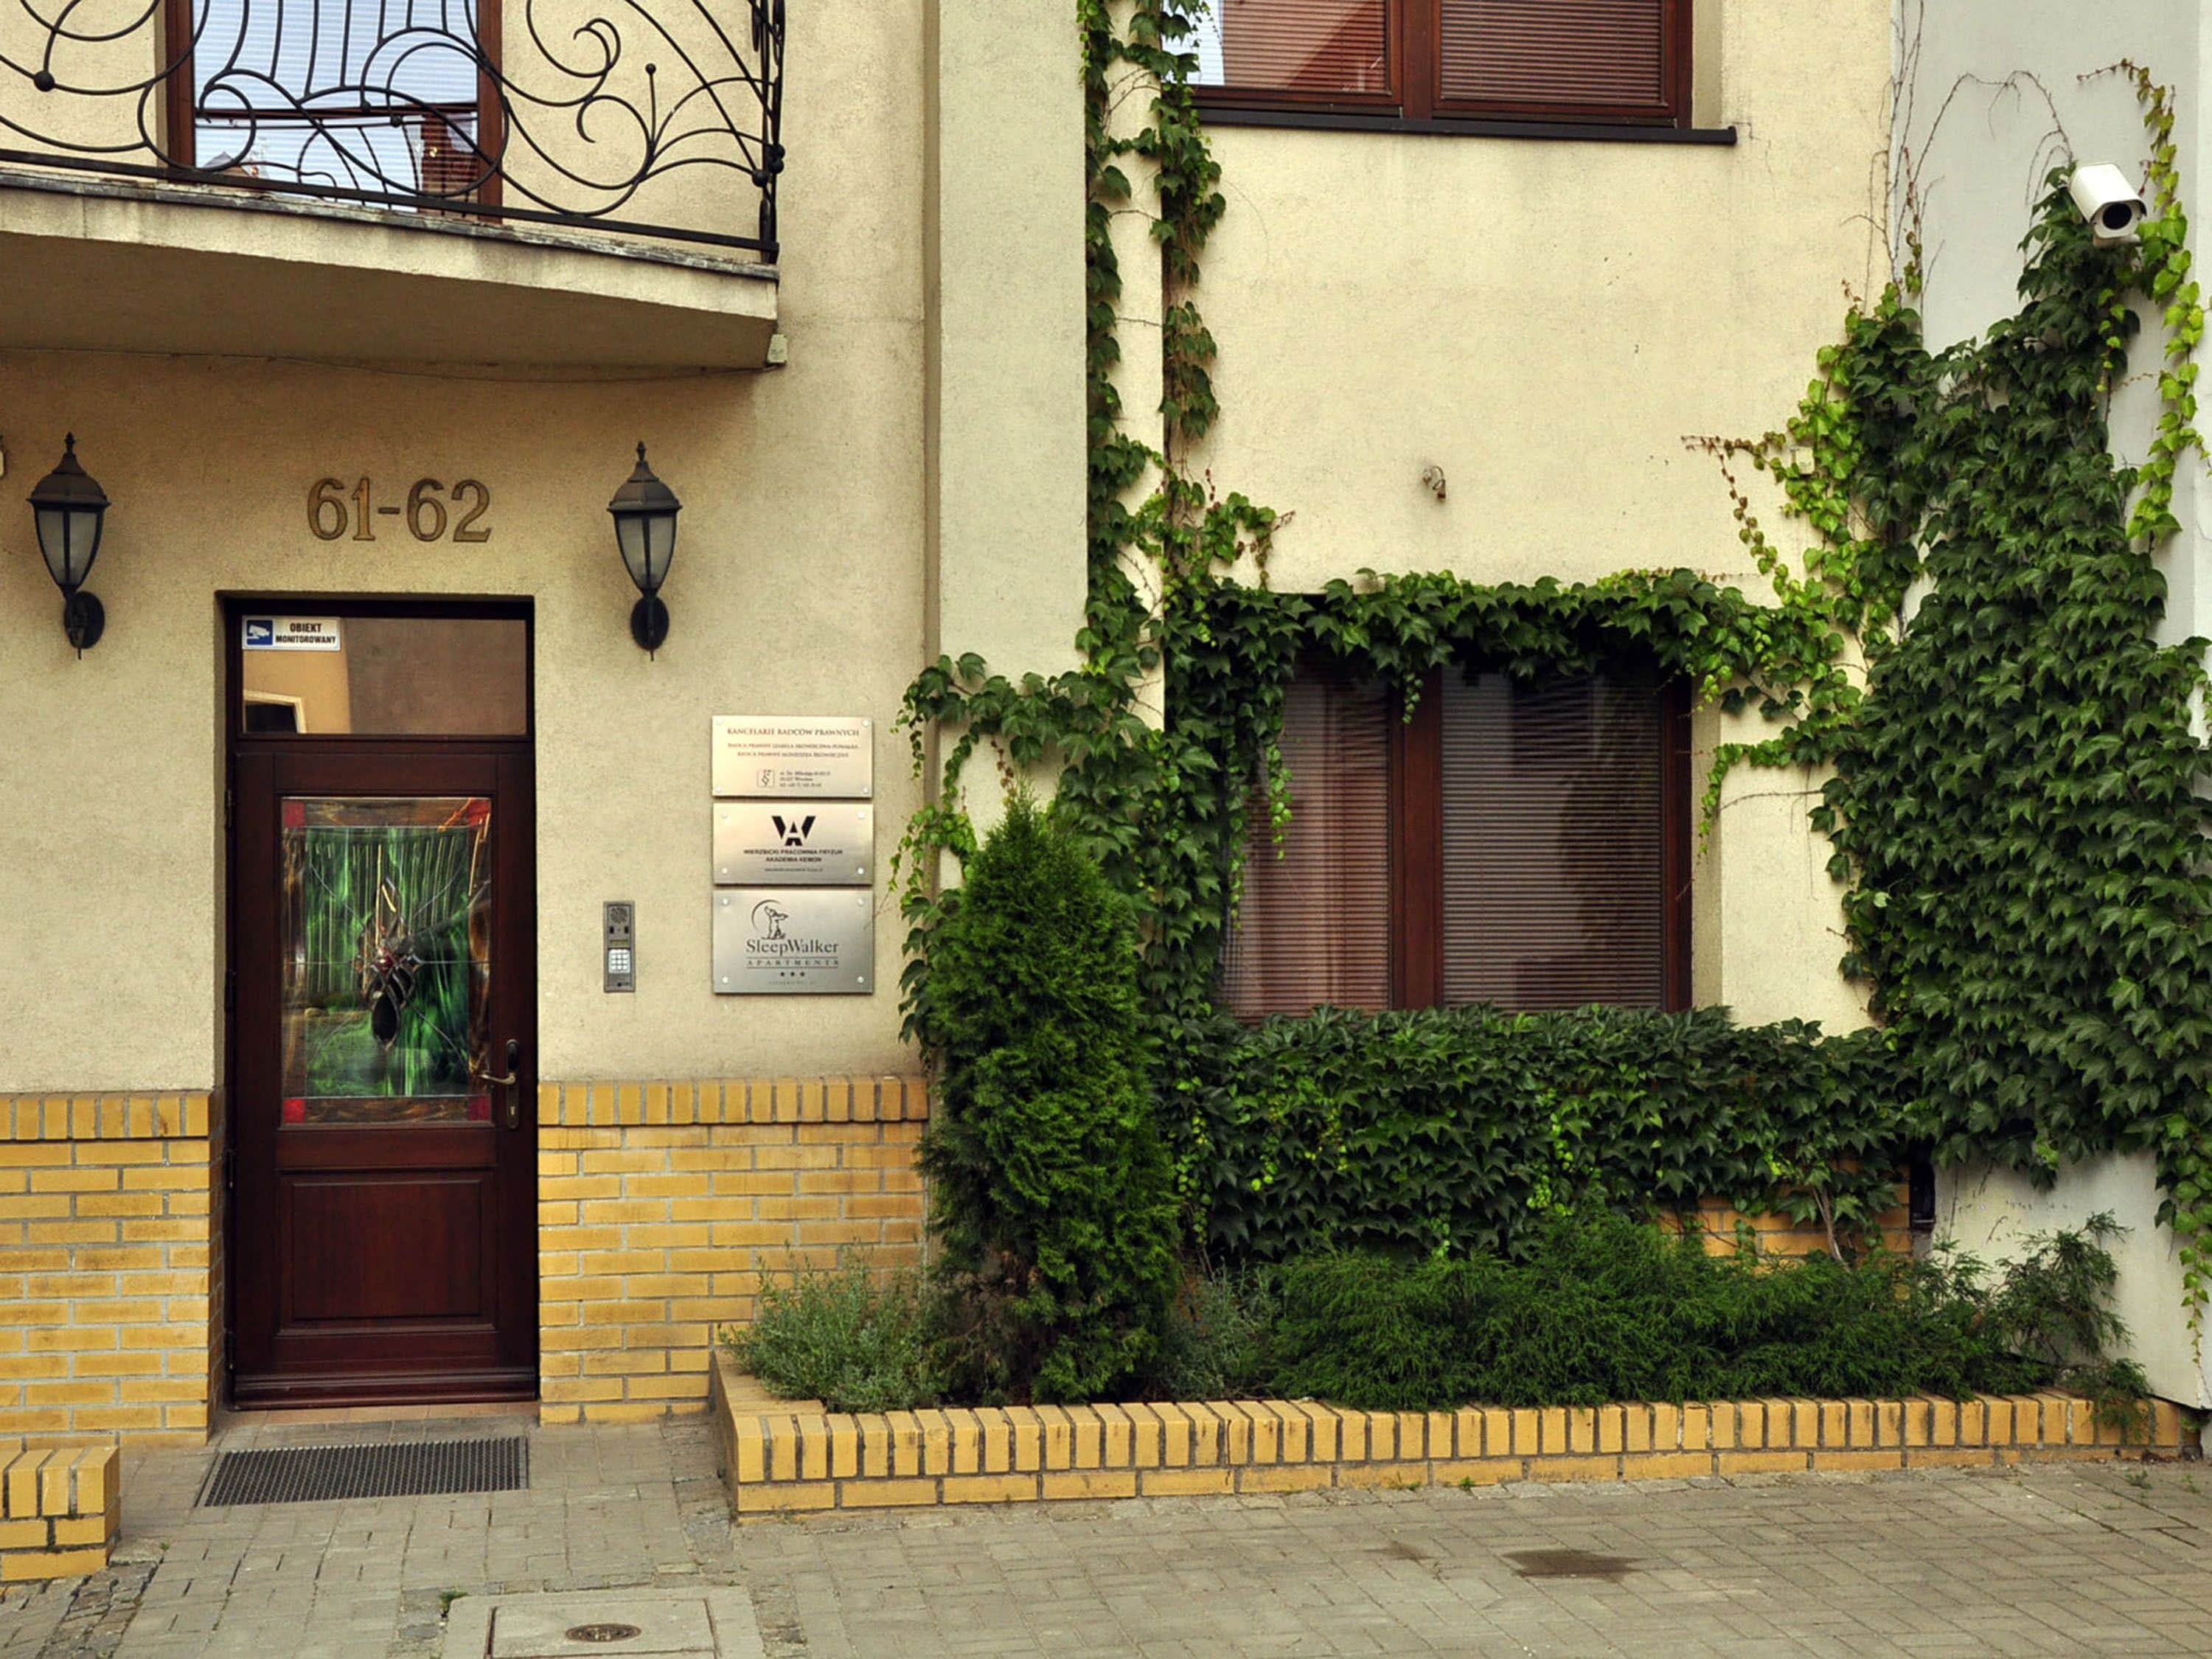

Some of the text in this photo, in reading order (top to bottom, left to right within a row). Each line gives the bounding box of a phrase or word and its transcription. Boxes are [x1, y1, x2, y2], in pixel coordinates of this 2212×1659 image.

[307, 477, 492, 543] 61-62
[289, 623, 322, 633] OBIEKT
[275, 635, 336, 644] MONITOROWANY
[745, 938, 839, 956] SleepWalker
